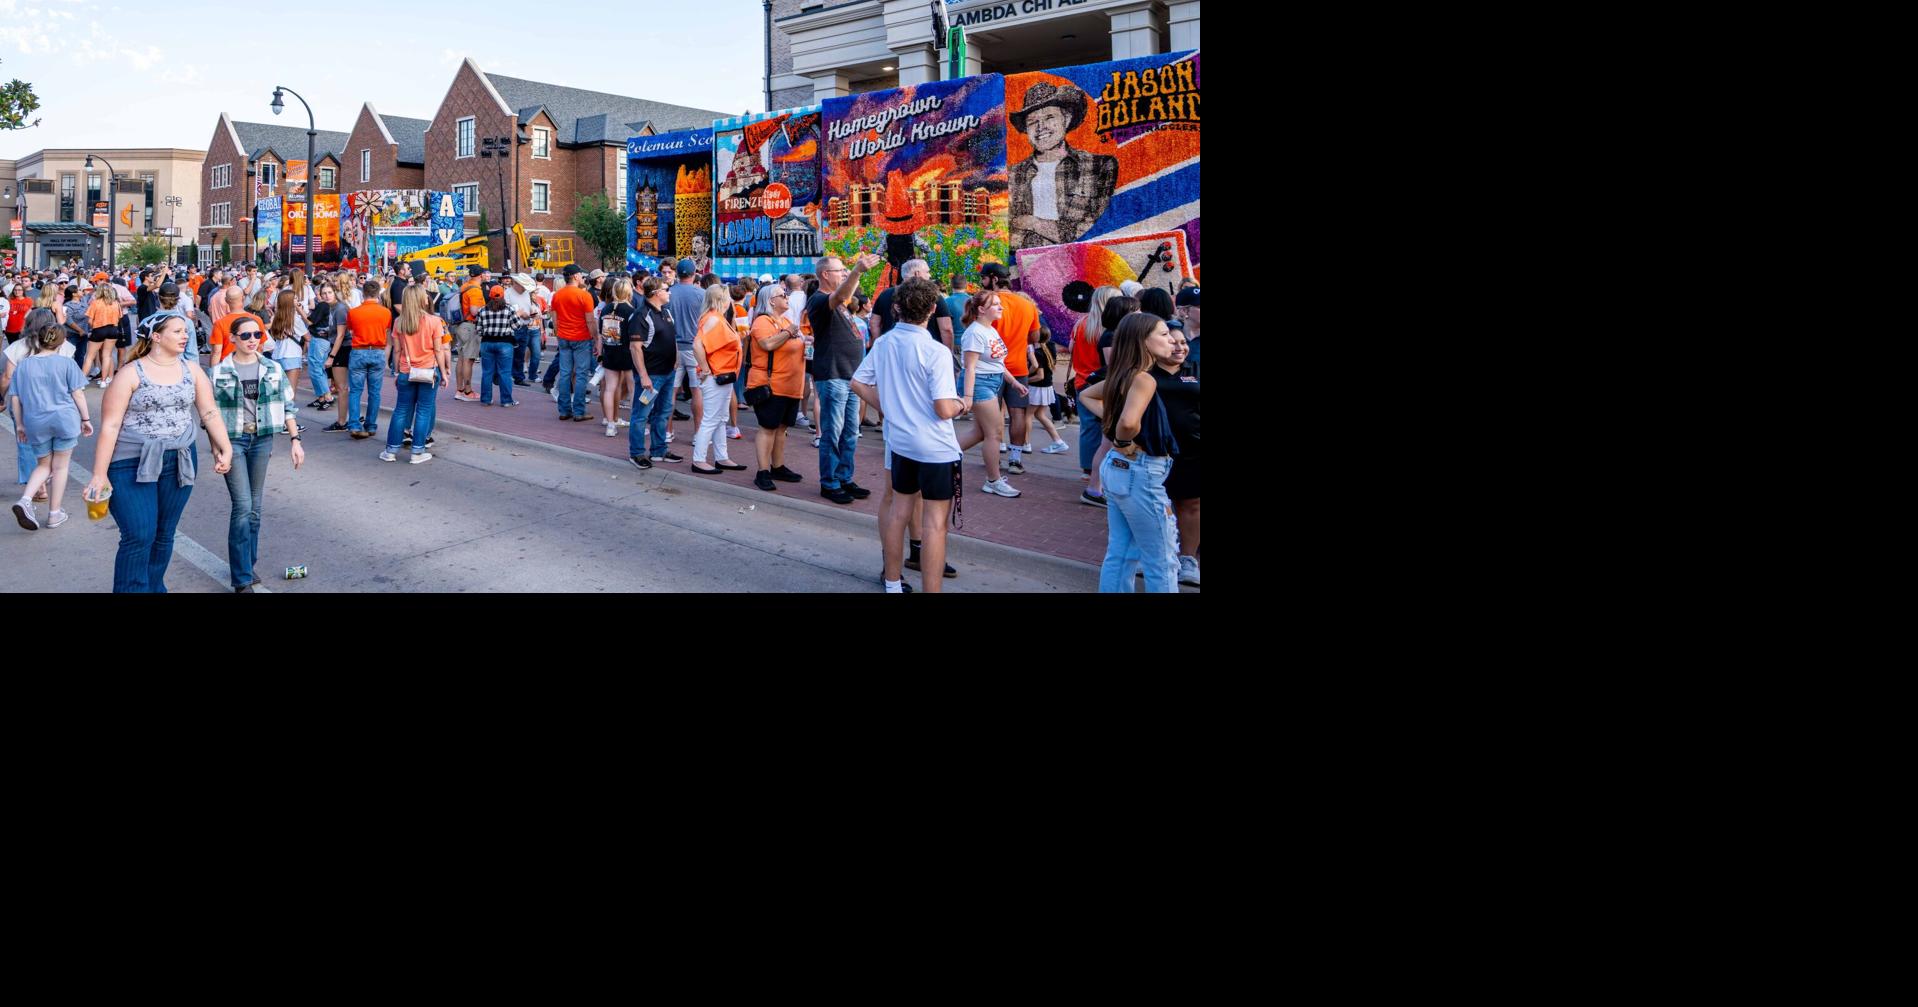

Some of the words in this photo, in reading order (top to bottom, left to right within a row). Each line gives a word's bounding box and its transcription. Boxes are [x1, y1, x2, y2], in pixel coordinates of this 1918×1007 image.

[949, 5, 1018, 28] AMBDA
[1102, 60, 1196, 102] JASON
[828, 95, 942, 141] Homegrown
[1096, 92, 1200, 132] BOLAND
[626, 139, 685, 154] Coleman
[849, 127, 906, 160] World
[911, 114, 980, 142] Known
[257, 196, 282, 211] GLOBAL
[288, 210, 339, 219] OKLHOMA
[302, 203, 325, 211] BYS
[719, 215, 771, 246] LONDON
